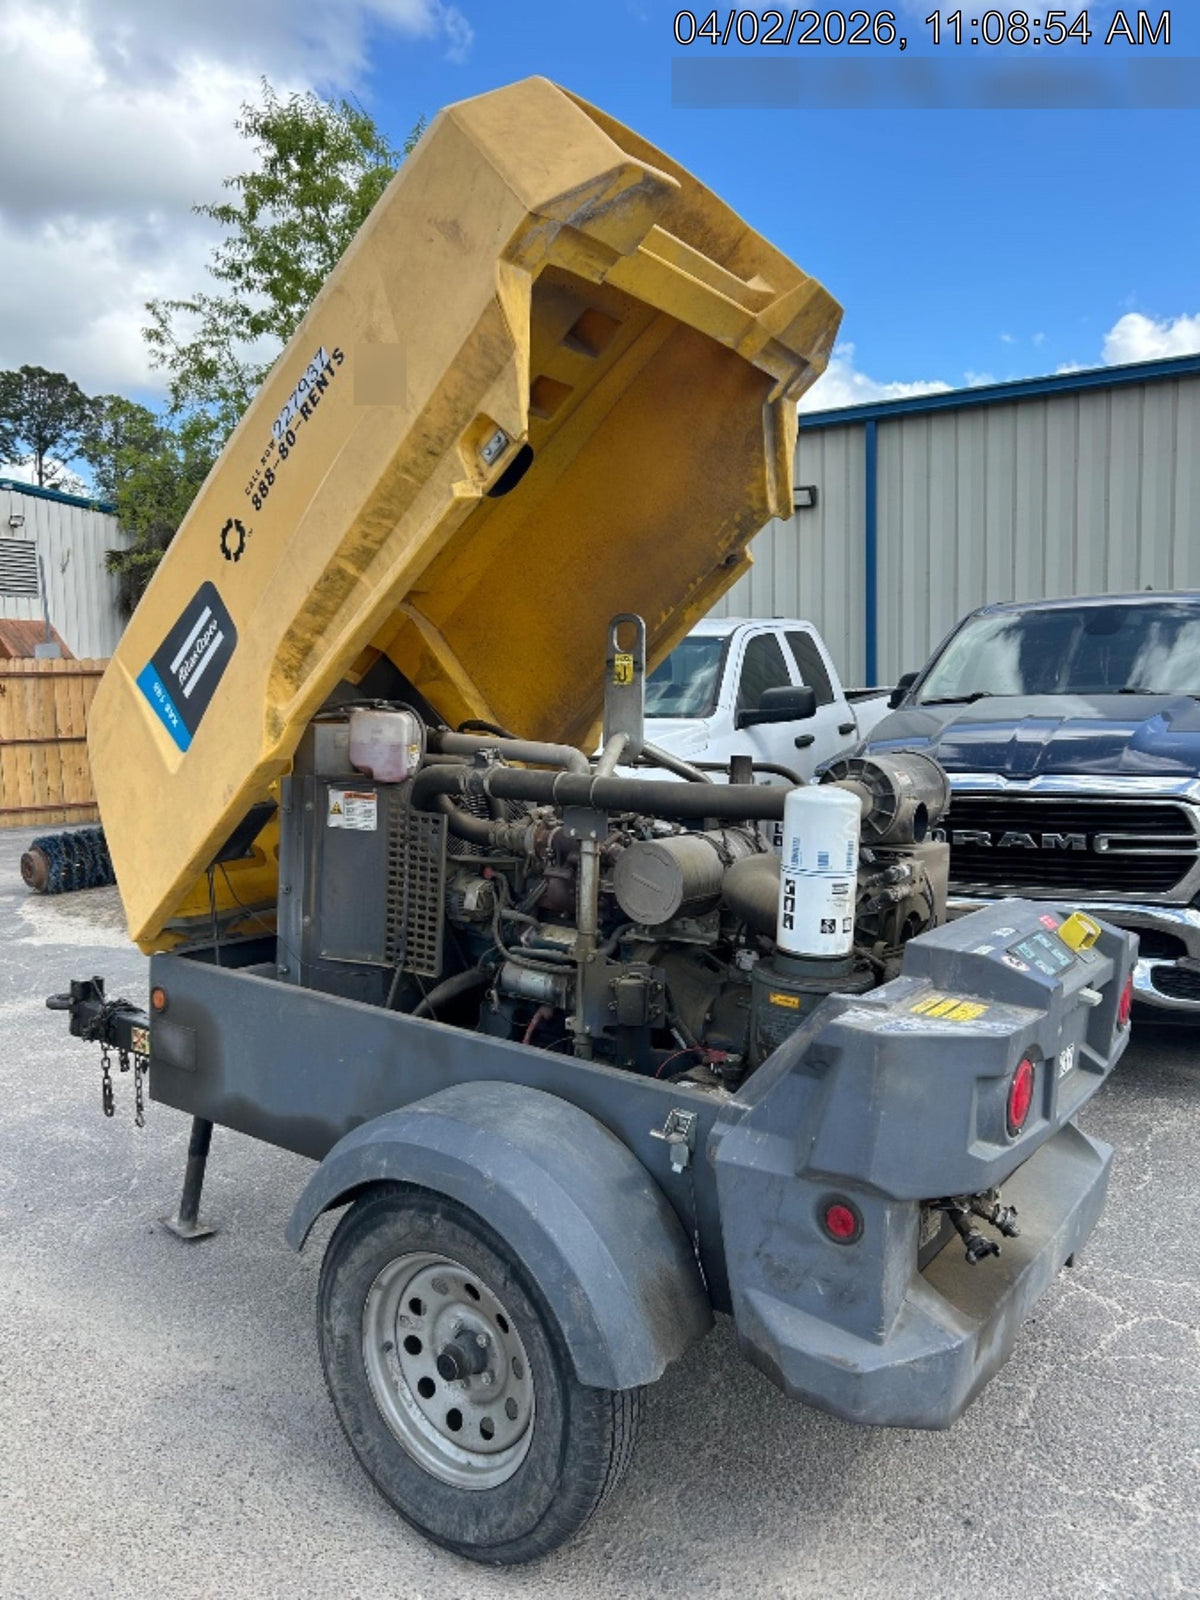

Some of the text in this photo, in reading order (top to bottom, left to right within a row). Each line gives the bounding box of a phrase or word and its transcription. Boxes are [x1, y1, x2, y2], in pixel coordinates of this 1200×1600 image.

[251, 347, 345, 511] 888-80-RENTS
[273, 346, 327, 440] 227937
[951, 829, 1088, 851] RAM
